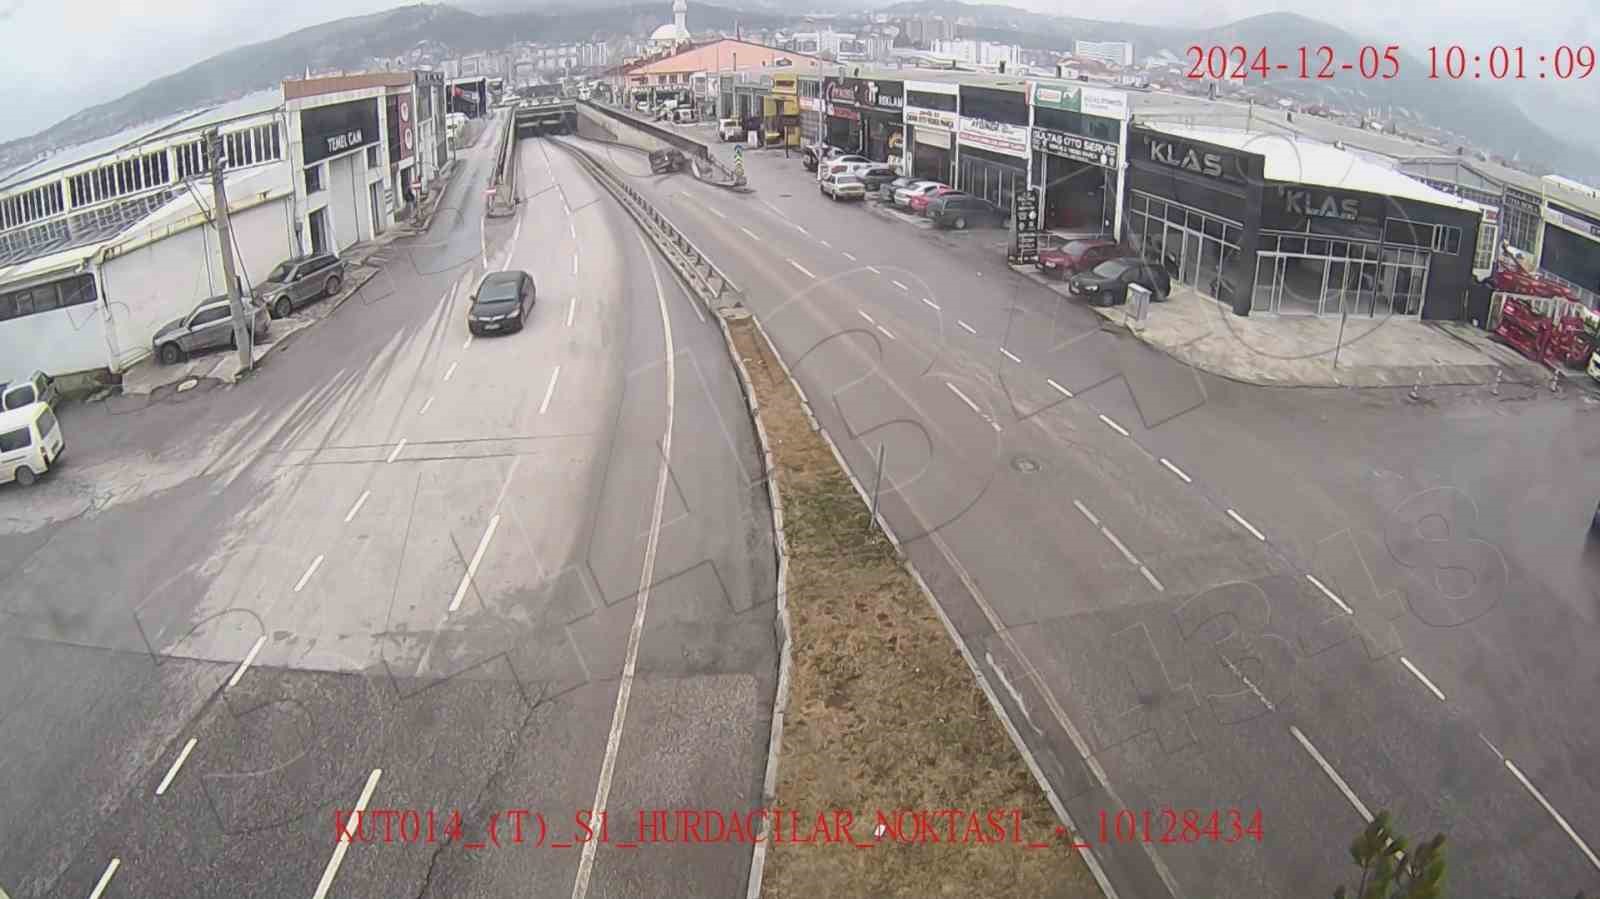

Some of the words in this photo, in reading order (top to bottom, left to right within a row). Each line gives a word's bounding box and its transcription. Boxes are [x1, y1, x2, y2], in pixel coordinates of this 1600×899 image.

[327, 134, 348, 153] TEMEL
[1151, 140, 1223, 177] KLAS
[1286, 188, 1359, 221] KLAS
